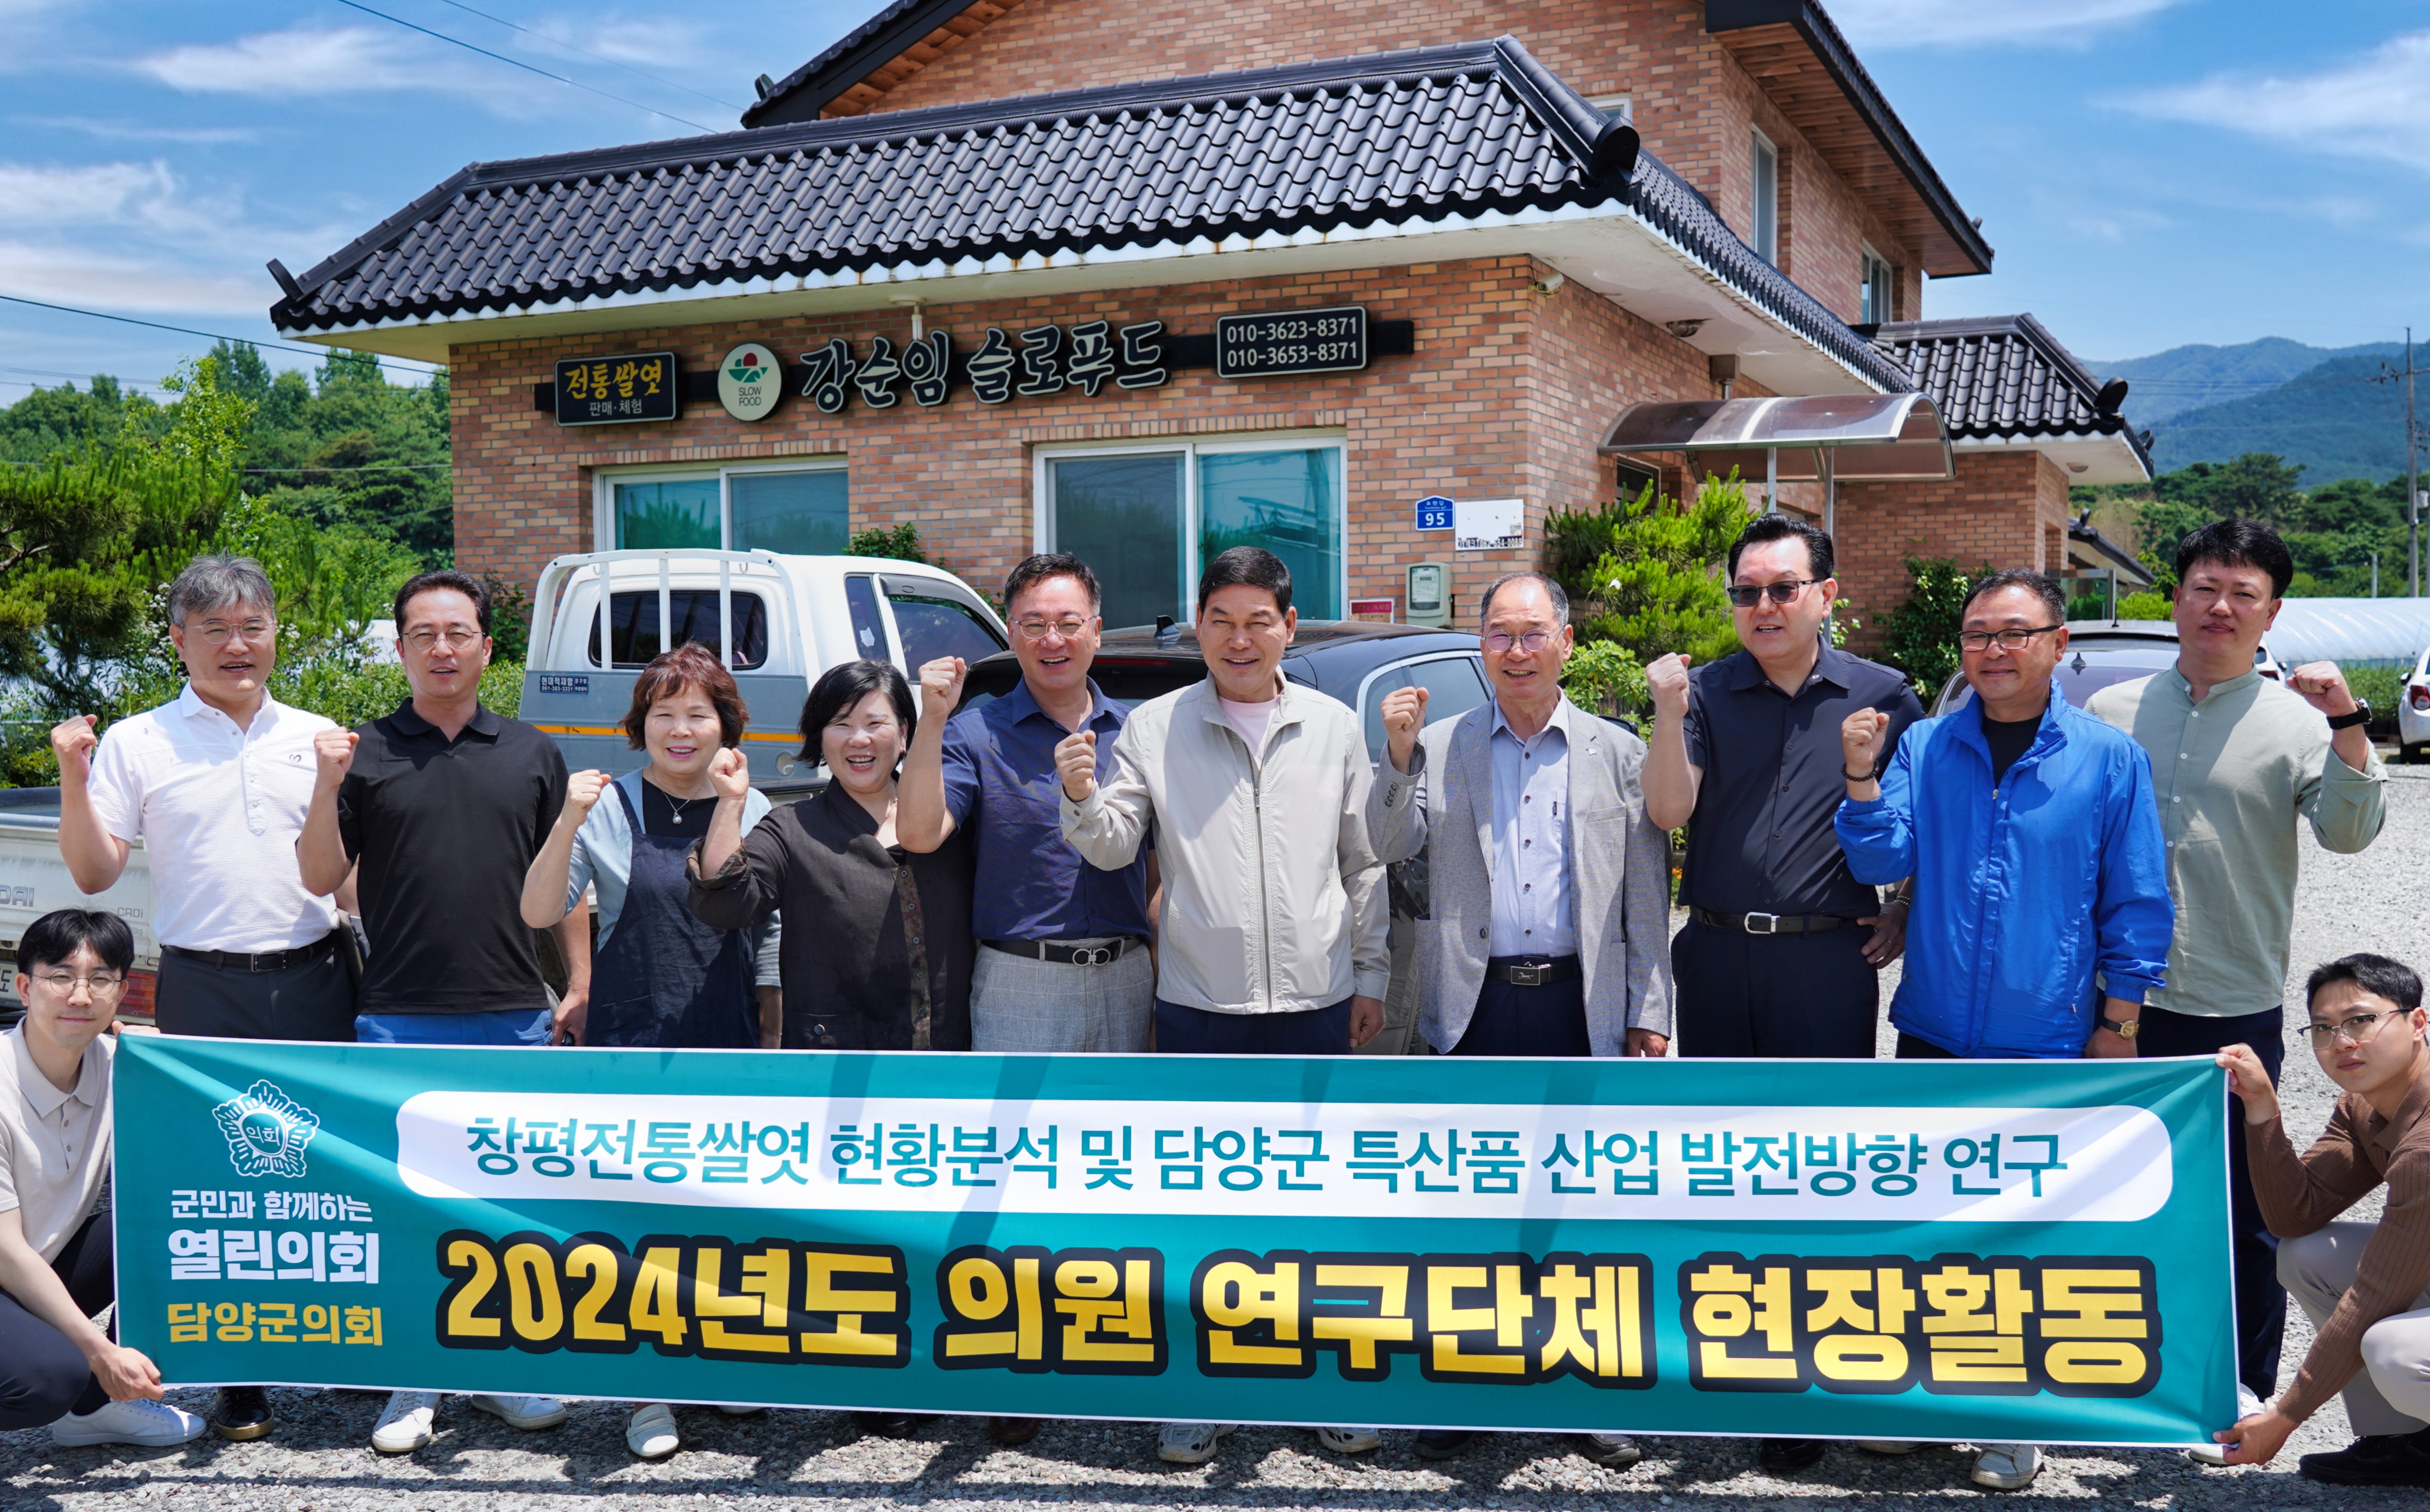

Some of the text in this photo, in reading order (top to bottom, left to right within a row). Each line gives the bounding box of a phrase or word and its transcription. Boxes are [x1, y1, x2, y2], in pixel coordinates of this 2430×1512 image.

[1227, 316, 1358, 343] 010-3623-8371
[800, 320, 1166, 414] 강순임 슬로푸드
[1227, 341, 1358, 367] 010-3653-8371
[566, 360, 662, 400] 전통쌀엿
[738, 386, 762, 397] SLOW
[589, 399, 642, 417] 판매·체험
[738, 396, 761, 406] FOOD
[1426, 512, 1445, 526] 95
[246, 1125, 280, 1146] 의회
[467, 1117, 2067, 1197] 창평전통쌀엿 현황분석 및 담양군 특산품 산업 발전방향 연구
[172, 1190, 373, 1222] 군민과 함께하는
[169, 1229, 380, 1284] 열린의회
[168, 1302, 382, 1346] 담양군의회
[447, 1240, 2148, 1384] 2024년도 의원 연구단체 현장활동
